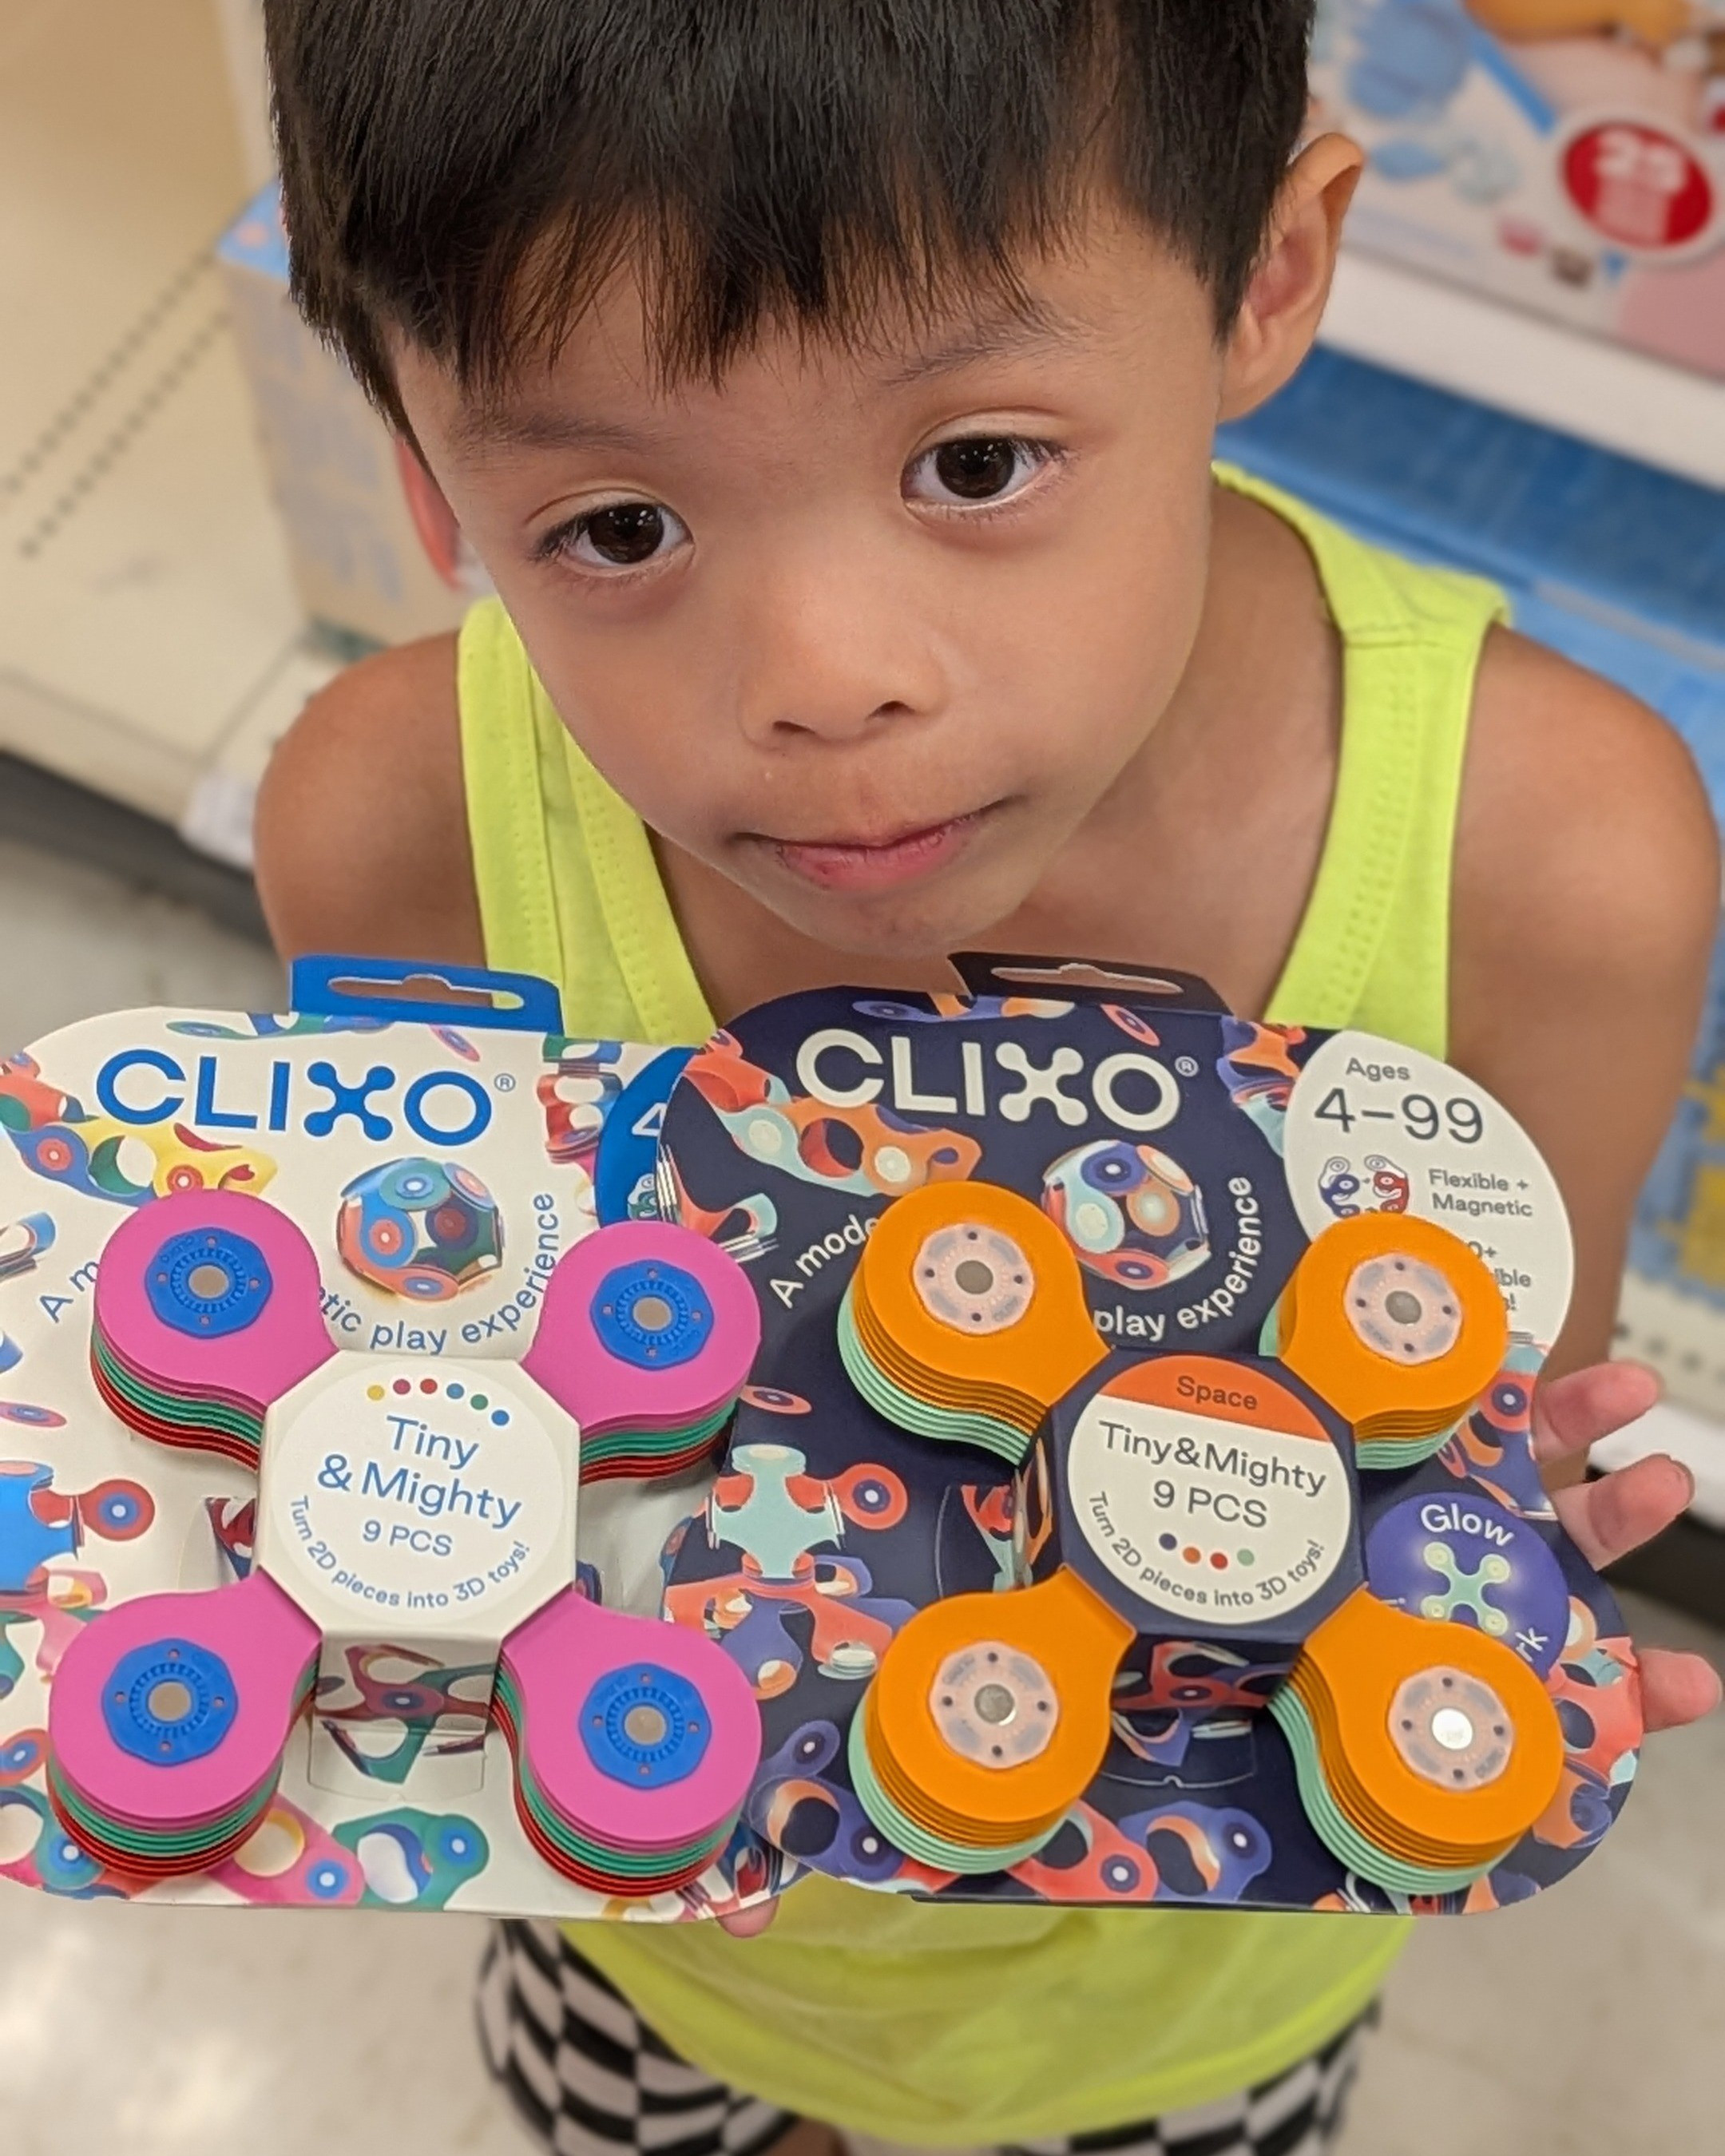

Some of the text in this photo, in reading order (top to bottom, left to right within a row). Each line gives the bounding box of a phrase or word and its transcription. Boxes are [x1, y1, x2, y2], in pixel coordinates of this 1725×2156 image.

[1346, 1057, 1410, 1081] Ages
[1428, 1168, 1509, 1191] Flexible
[1432, 1193, 1533, 1216] Magnetic
[40, 1295, 74, 1324] A
[369, 1321, 447, 1355] play
[461, 1193, 560, 1344] experience
[770, 1177, 1262, 1342] A mode play experience
[1176, 1375, 1258, 1410] Space
[387, 1414, 479, 1470] Tiny
[1099, 1420, 1326, 1498] Tiny&Mighty
[317, 1453, 521, 1529] & Mighty
[1153, 1480, 1267, 1528] 9 PCS
[363, 1520, 453, 1557] 9 PCS
[1089, 1491, 1325, 1607] Turn 2D pieces into 3D toys!
[1420, 1503, 1514, 1546] Glow
[290, 1495, 530, 1608] Turn 2D pieces into 3D toys!
